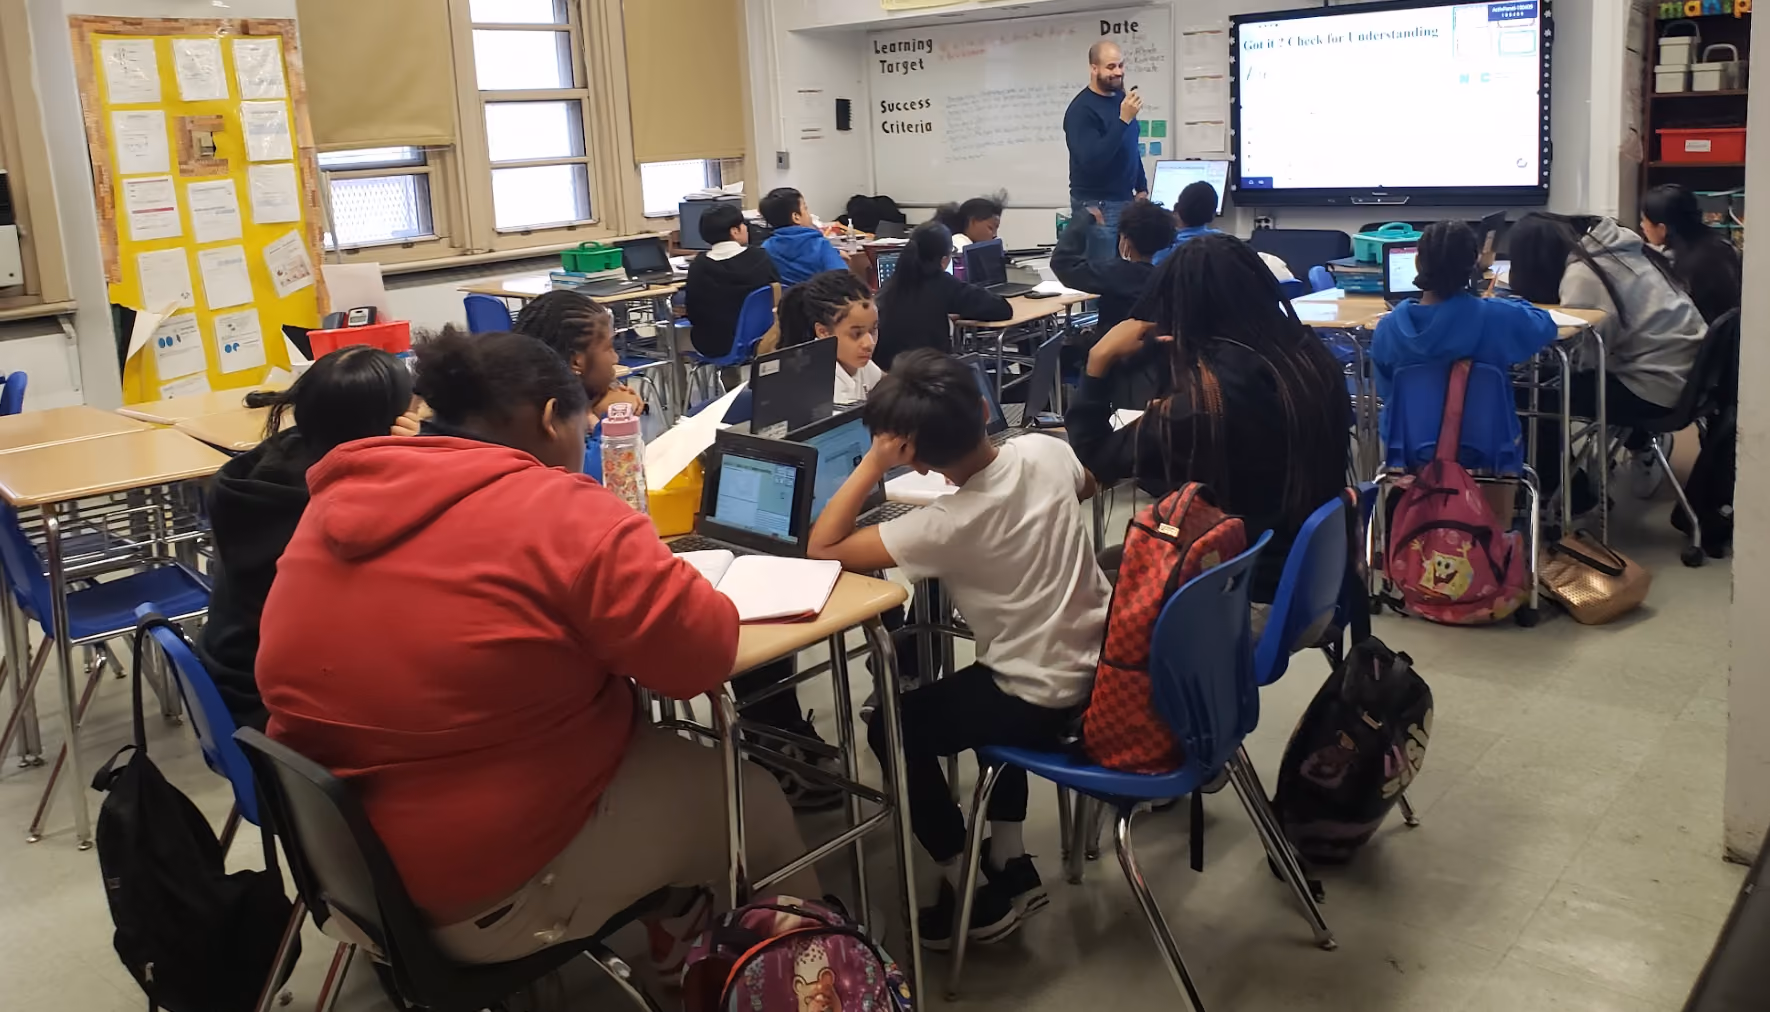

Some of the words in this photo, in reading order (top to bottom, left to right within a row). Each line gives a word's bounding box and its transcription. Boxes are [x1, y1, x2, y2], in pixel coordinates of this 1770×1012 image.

[1100, 20, 1139, 36] Date
[873, 38, 933, 54] Learning
[1243, 39, 1263, 51] Got
[1287, 34, 1323, 47] Check
[1327, 32, 1345, 44] for
[1348, 26, 1439, 43] Understanding
[879, 58, 924, 75] Target
[880, 98, 931, 113] Success
[881, 119, 932, 134] Criteria
